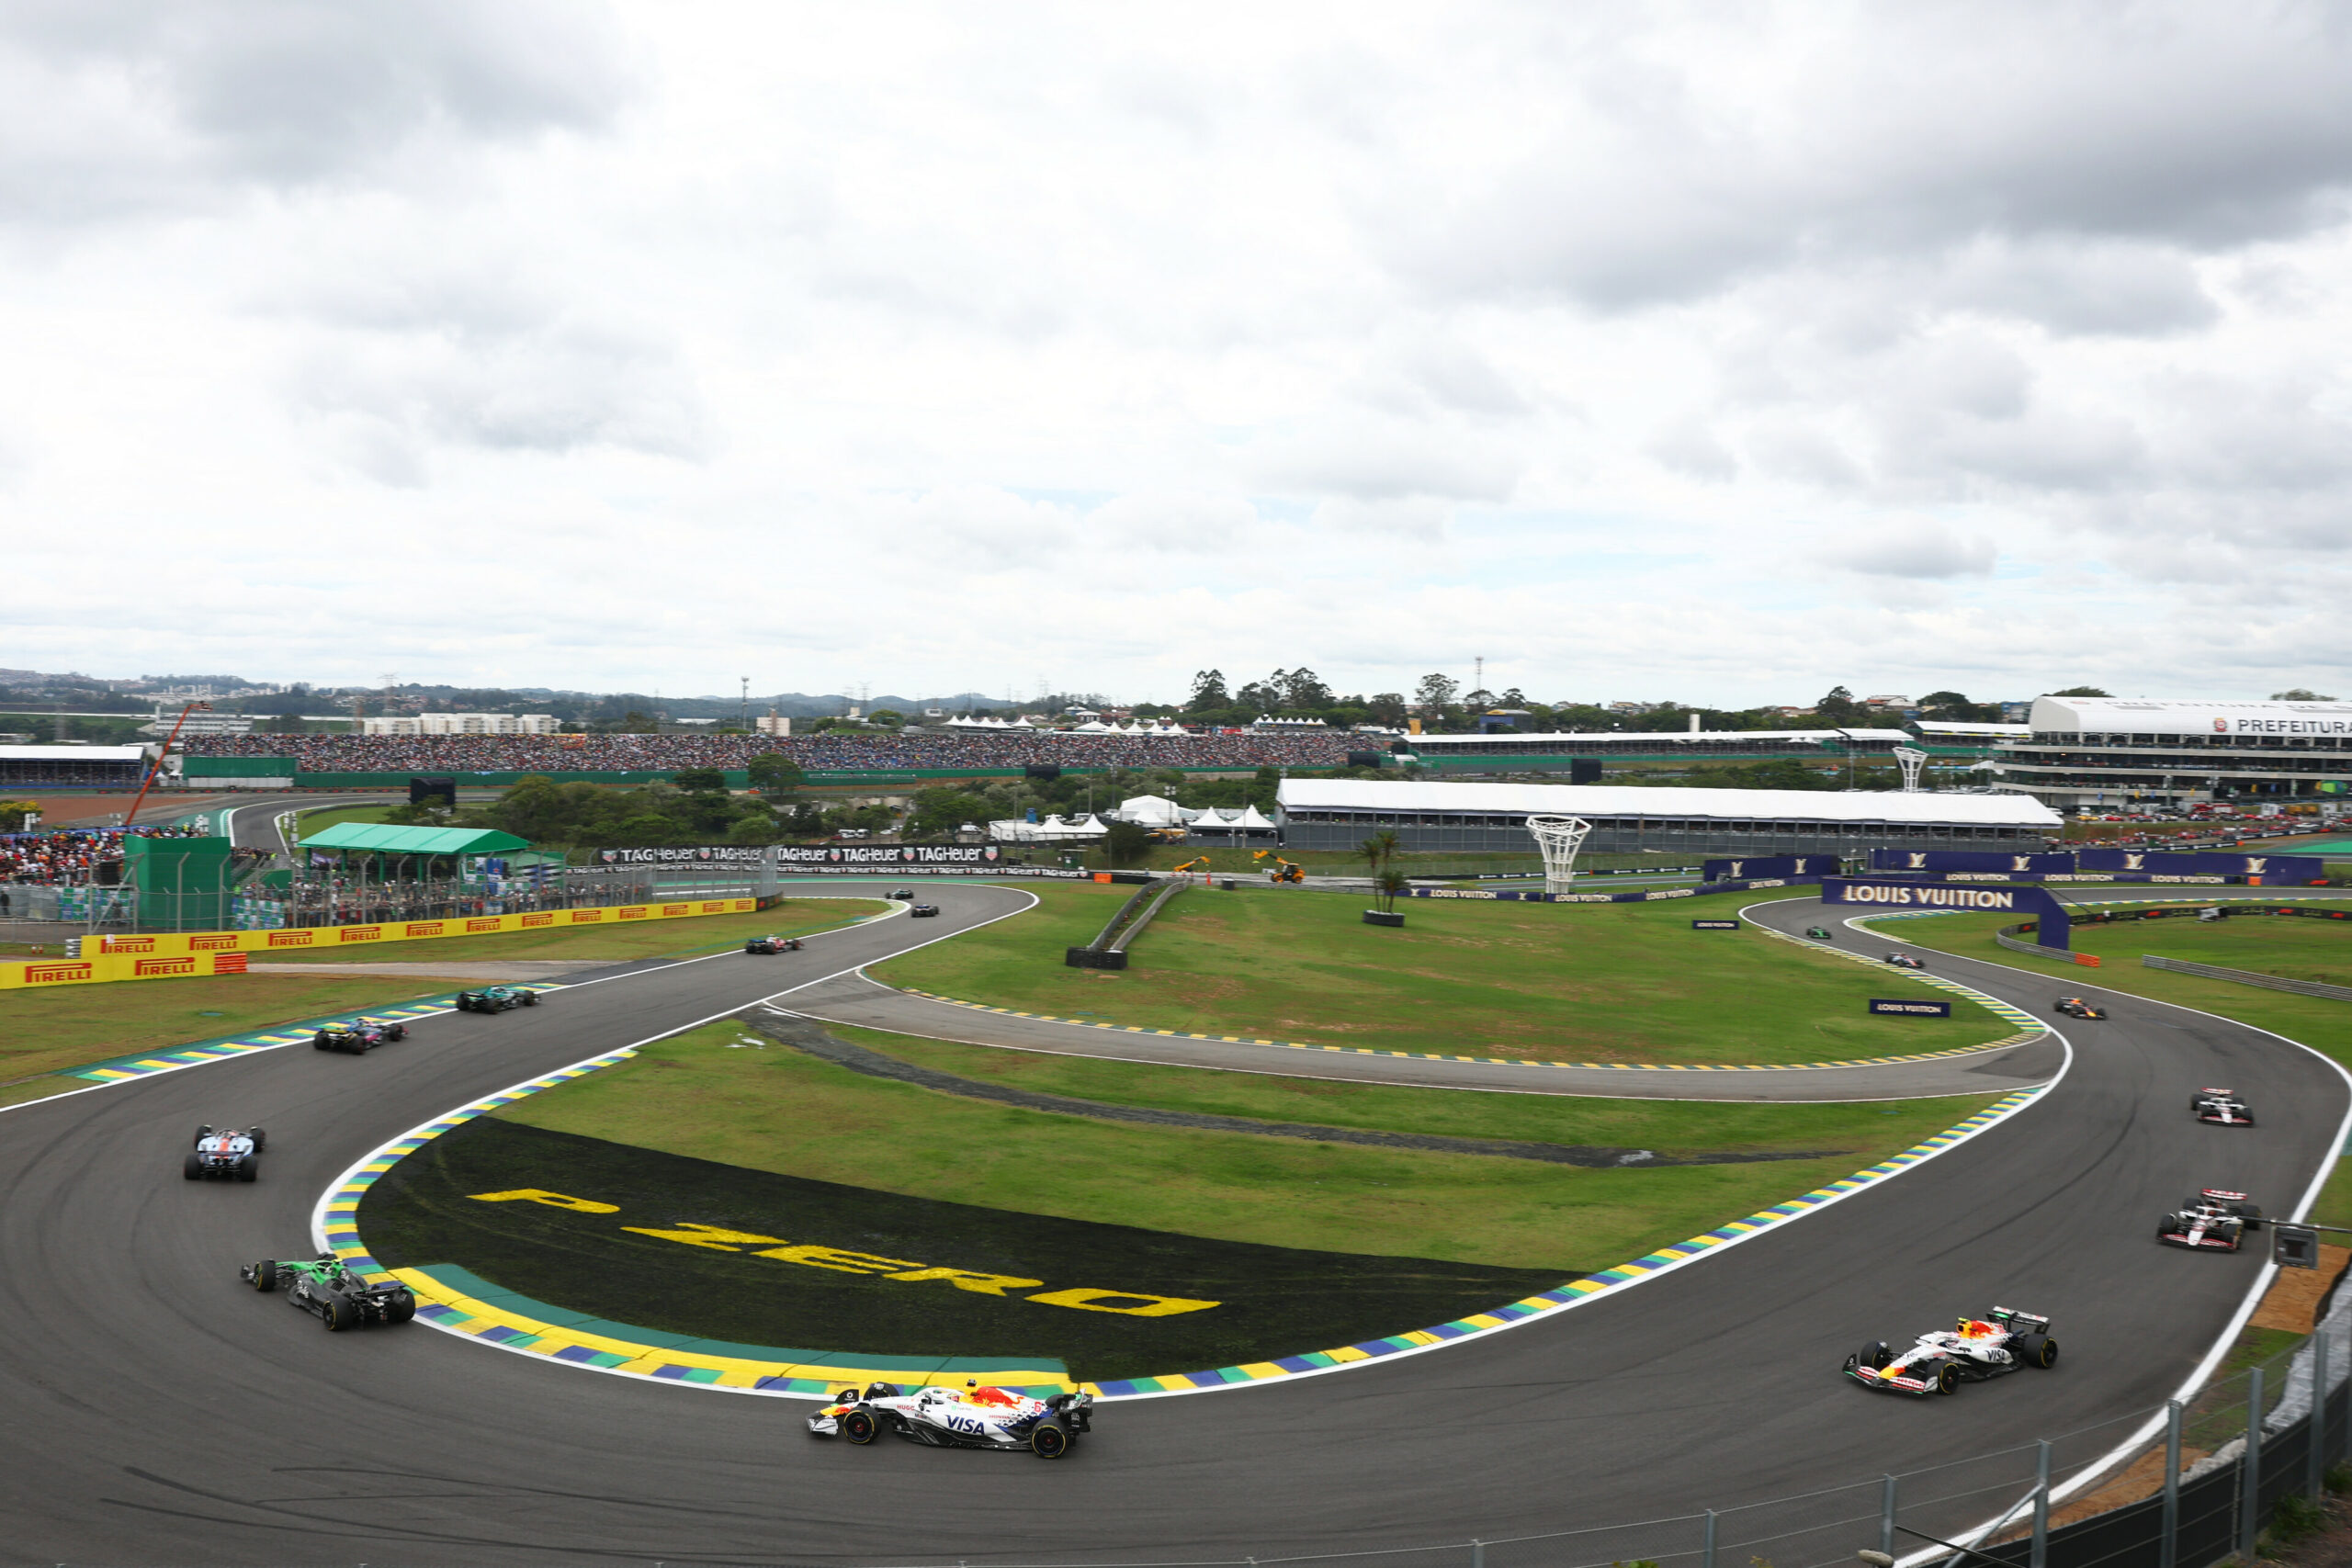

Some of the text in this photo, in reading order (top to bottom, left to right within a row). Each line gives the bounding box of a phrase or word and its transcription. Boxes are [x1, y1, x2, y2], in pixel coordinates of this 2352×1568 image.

[1843, 885, 2013, 908] LOUIS VUITTON
[522, 914, 553, 927] PIRELLI
[572, 910, 602, 922] PIRELLI
[406, 922, 443, 937] PIRELLI
[467, 919, 500, 932] PIRELLI
[268, 931, 312, 946] PIRELLI
[341, 927, 381, 942] PIRELLI
[99, 938, 154, 953] PIRELLI
[189, 934, 238, 951] PIRELLI
[25, 963, 92, 983] PIRELLI
[135, 957, 195, 976] PIRELLI
[465, 1188, 621, 1213] P
[1034, 1401, 1042, 1413] 6
[944, 1415, 985, 1435] VISA
